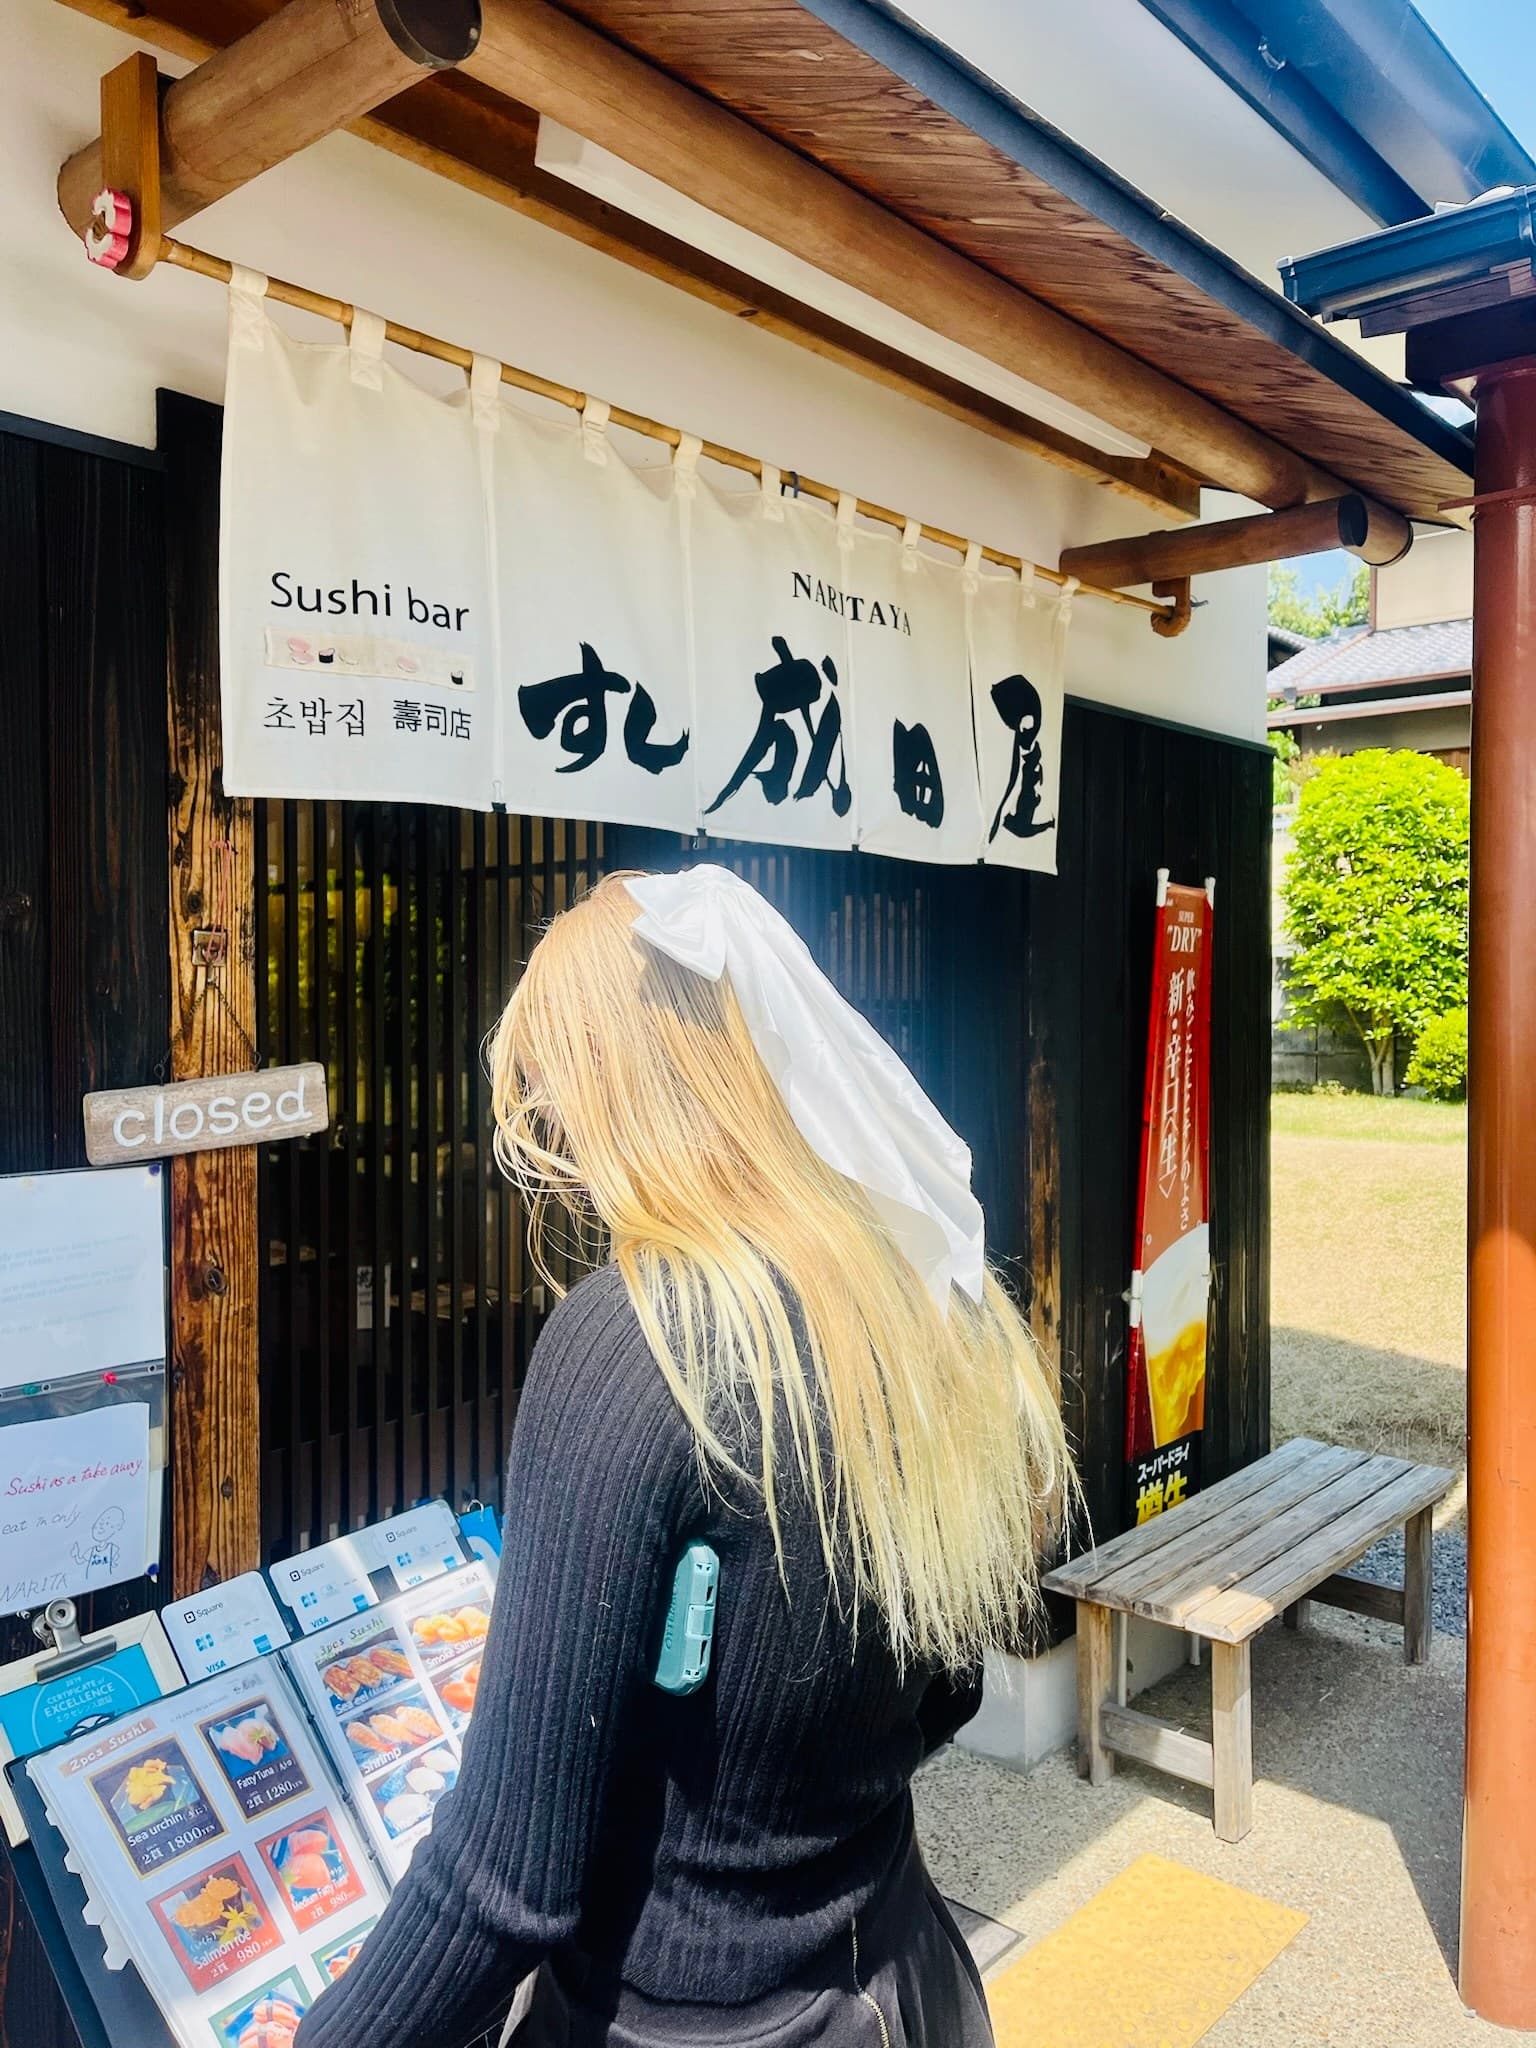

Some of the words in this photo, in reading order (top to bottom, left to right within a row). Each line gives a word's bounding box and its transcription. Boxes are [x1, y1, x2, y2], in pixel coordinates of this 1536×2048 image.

[271, 572, 392, 617] Sushi
[407, 586, 470, 631] bar
[792, 572, 911, 636] NARITAYA
[264, 697, 365, 738] 초밥집
[393, 699, 472, 740] 壽司店
[113, 1076, 312, 1147] closed
[5, 1477, 47, 1496] Sushi
[81, 1461, 108, 1481] take
[1137, 1441, 1191, 1484] スーパードライ
[1136, 1470, 1188, 1526] 樽生
[1, 1519, 29, 1535] eat
[52, 1504, 81, 1528] only
[0, 1572, 69, 1602] NARITA
[300, 1562, 325, 1577] Square
[196, 1602, 224, 1618] Square
[311, 1616, 329, 1628] VISA
[350, 1615, 384, 1641] Sushi
[206, 1660, 227, 1673] VISA
[43, 1682, 115, 1718] EXCELLENCE
[47, 1680, 97, 1704] CERTIFICATE
[334, 1701, 354, 1714] Sea
[69, 1748, 103, 1772] 2pcs
[108, 1722, 147, 1752] Sushi
[237, 1772, 258, 1790] Fatty
[255, 1766, 275, 1781] Tuna
[127, 1831, 149, 1847] Sea
[149, 1812, 183, 1835] urchin
[193, 1939, 235, 1969] Salmon
[234, 1929, 252, 1945] roe
